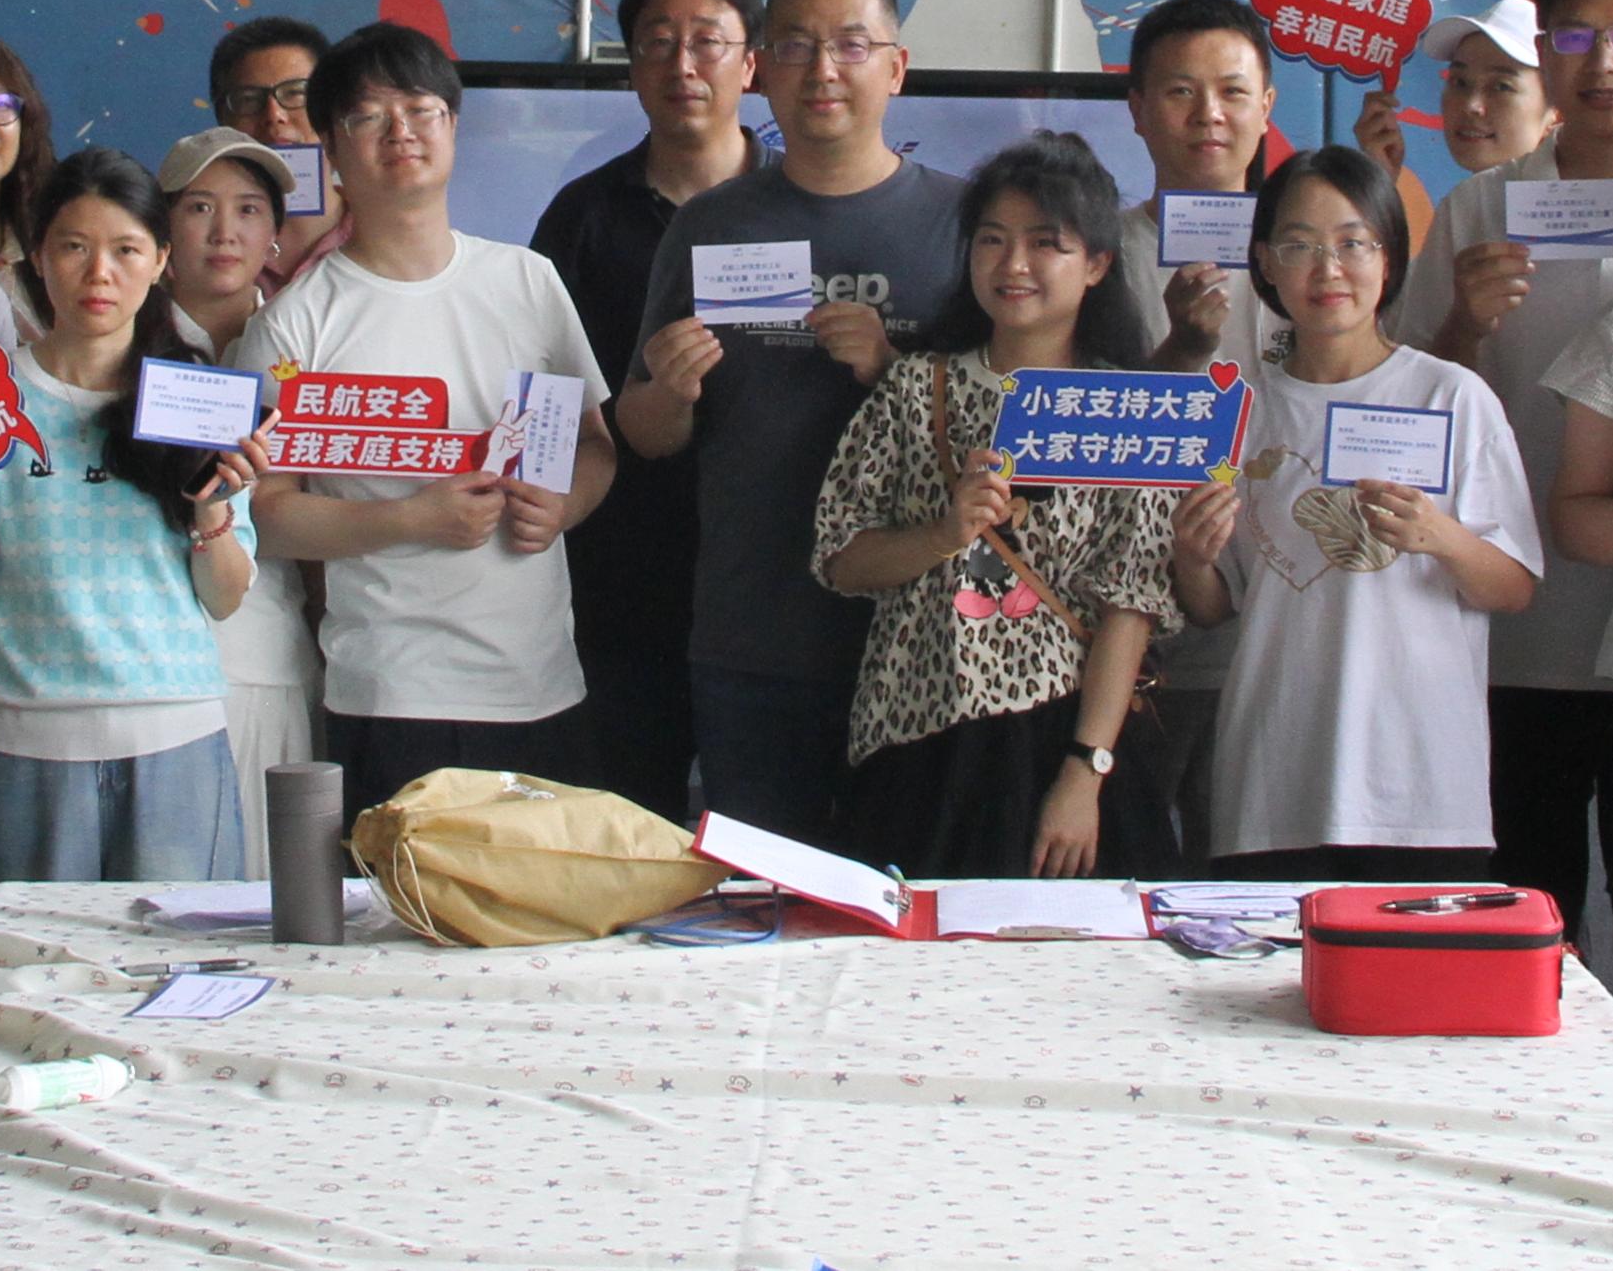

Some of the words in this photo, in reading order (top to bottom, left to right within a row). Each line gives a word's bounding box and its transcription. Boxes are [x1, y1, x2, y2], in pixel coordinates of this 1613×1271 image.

[1273, 5, 1399, 68] 幸福民航
[810, 273, 890, 305] eep
[293, 383, 433, 421] 民航安全
[1020, 385, 1217, 422] 小家支持大家
[266, 431, 464, 470] 有我家庭支持
[1012, 430, 1209, 467] 大家守护万家
